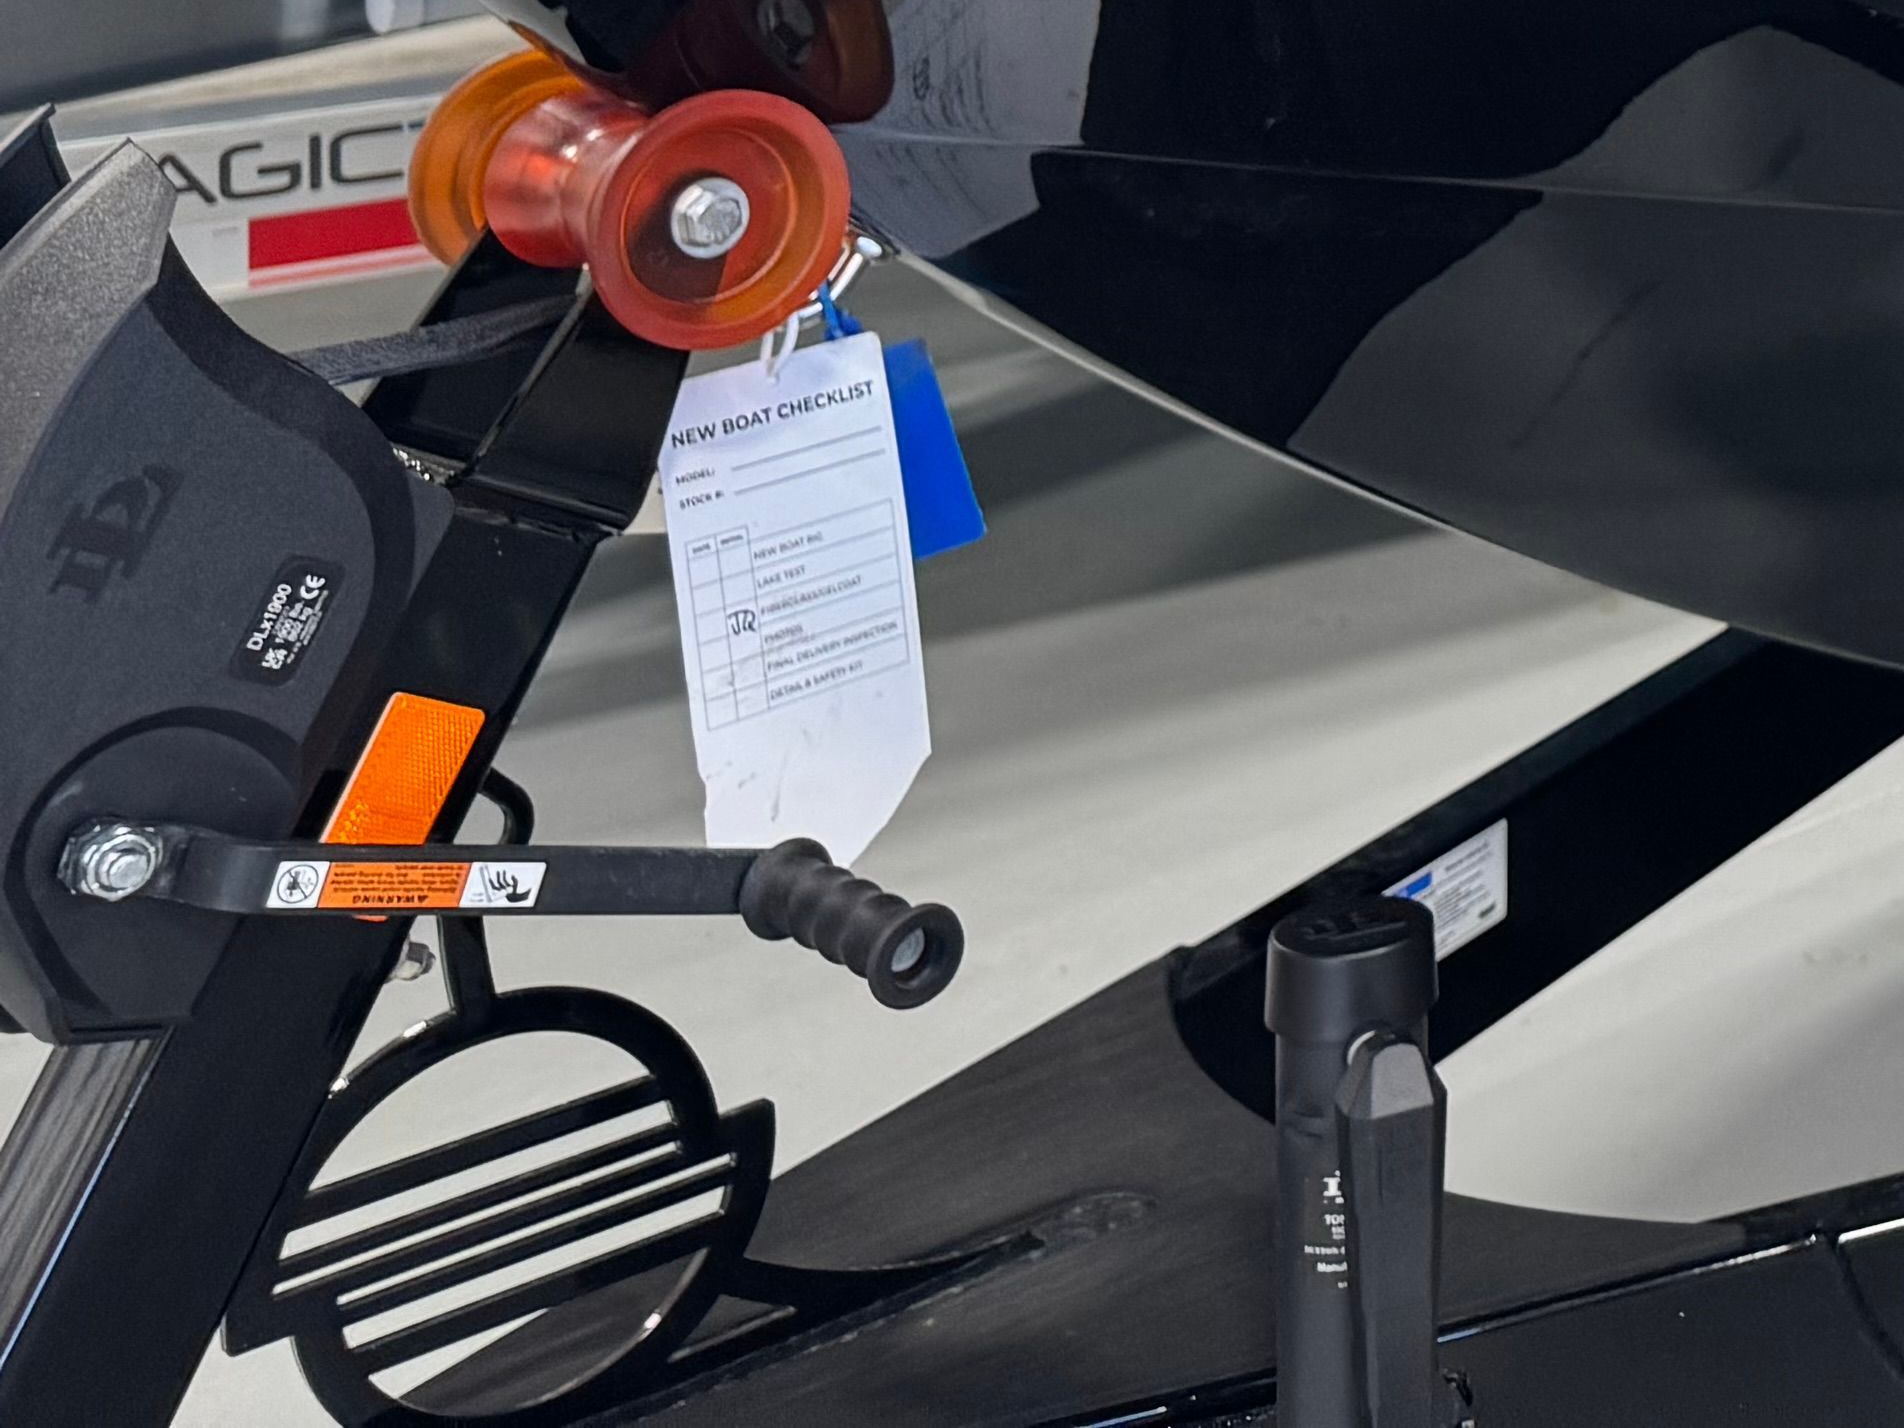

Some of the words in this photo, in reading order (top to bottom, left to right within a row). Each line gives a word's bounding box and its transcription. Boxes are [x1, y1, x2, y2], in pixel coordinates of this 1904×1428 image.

[158, 119, 425, 204] AGIC
[671, 421, 716, 448] NEW
[722, 407, 772, 436] BOAT
[776, 380, 873, 420] CHECKLIST
[352, 894, 419, 905] WARNING
